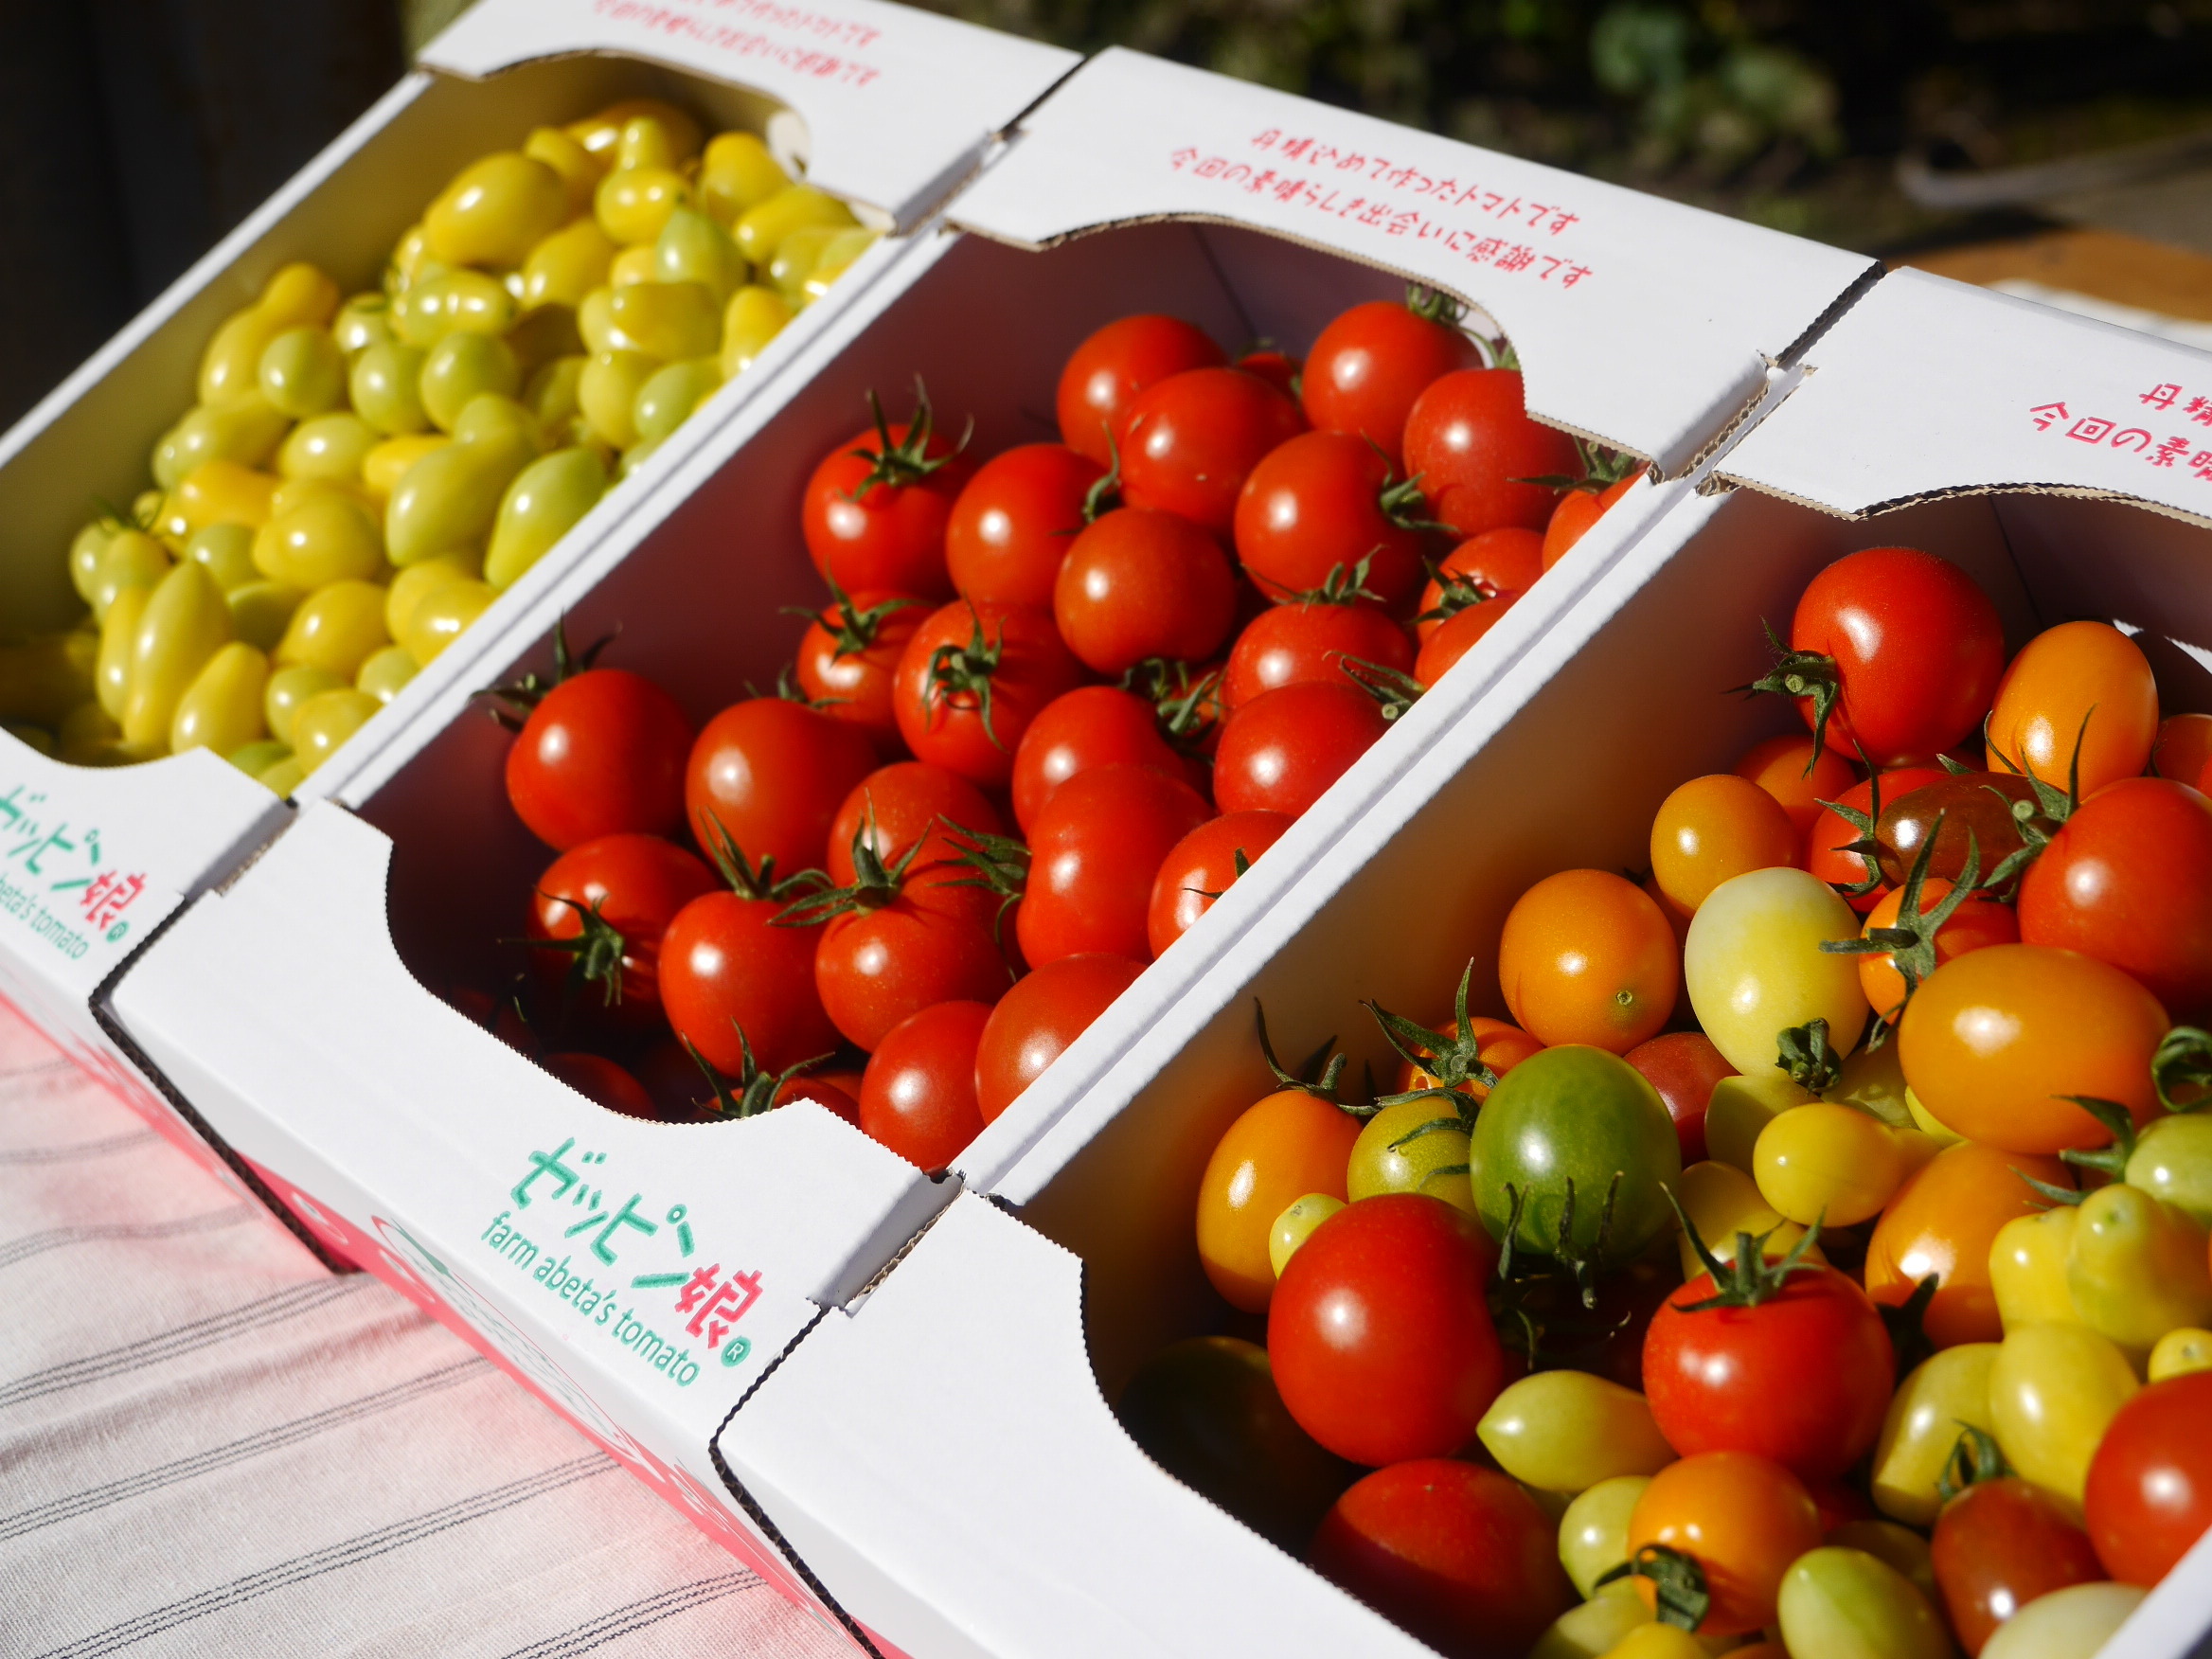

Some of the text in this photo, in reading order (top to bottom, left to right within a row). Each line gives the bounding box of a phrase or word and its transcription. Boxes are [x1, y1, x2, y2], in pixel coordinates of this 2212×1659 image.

[29, 905, 90, 960] tomato
[481, 1211, 701, 1387] farm abeta's tomato
[510, 1136, 763, 1348] ゼッピン娘
